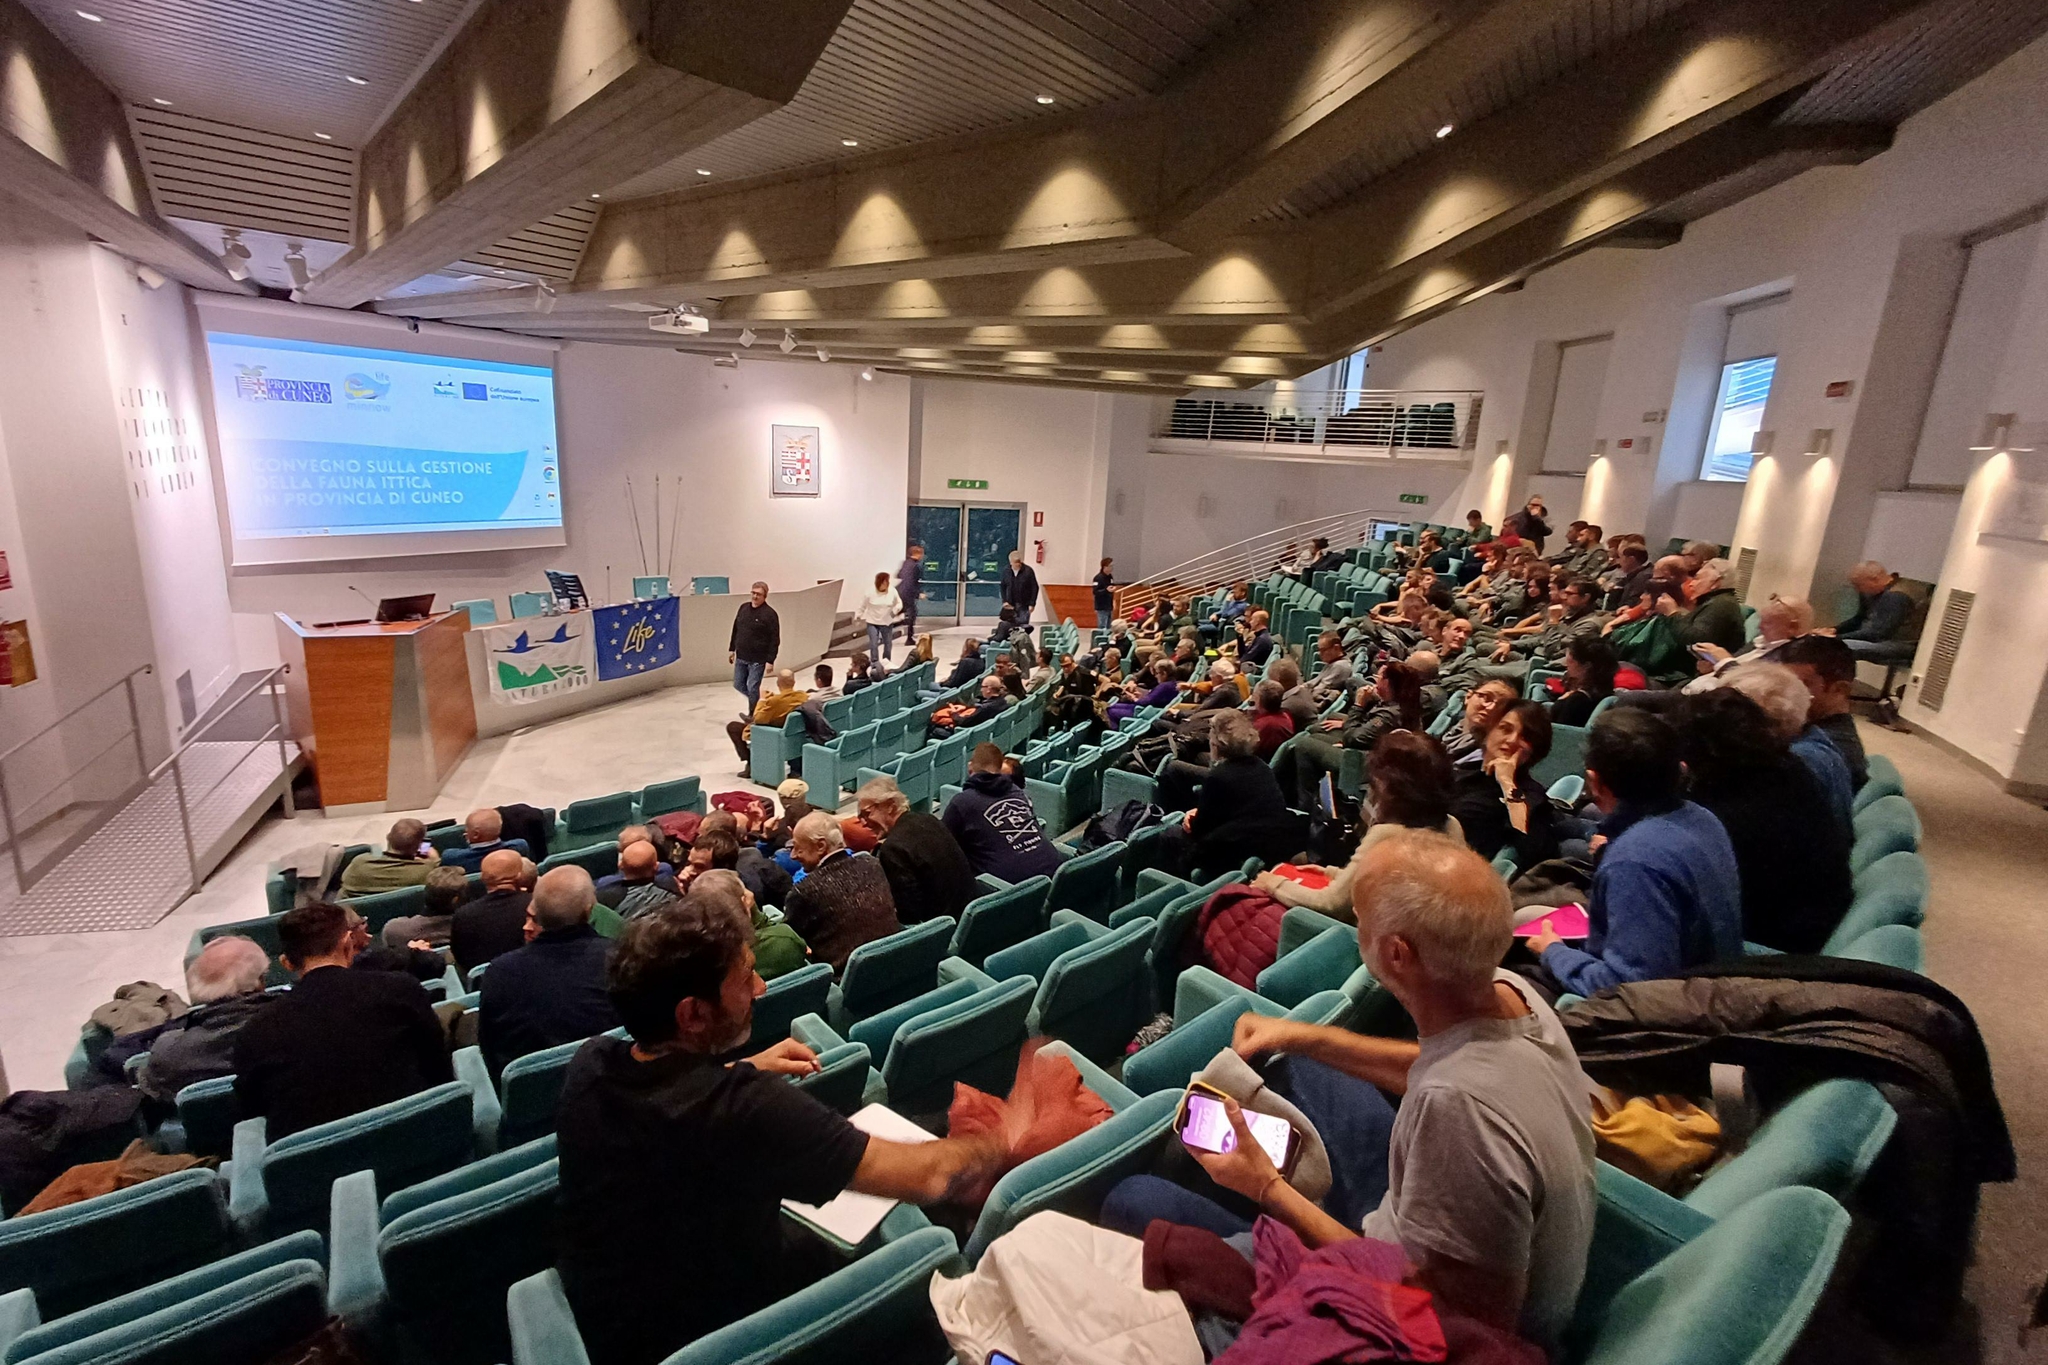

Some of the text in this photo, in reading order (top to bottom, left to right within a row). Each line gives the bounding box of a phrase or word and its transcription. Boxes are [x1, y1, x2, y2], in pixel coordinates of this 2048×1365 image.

[374, 371, 390, 381] life
[267, 380, 330, 392] PROVINCIA
[281, 389, 331, 403] CUNEO
[254, 458, 493, 474] CONVEGNO SULLA GESTIONE
[256, 475, 432, 490] DELLA FAUNA ITTICA
[284, 491, 384, 506] PROVINCIA
[388, 491, 406, 505] DI
[411, 490, 465, 504] CUNEO
[623, 616, 655, 653] Life
